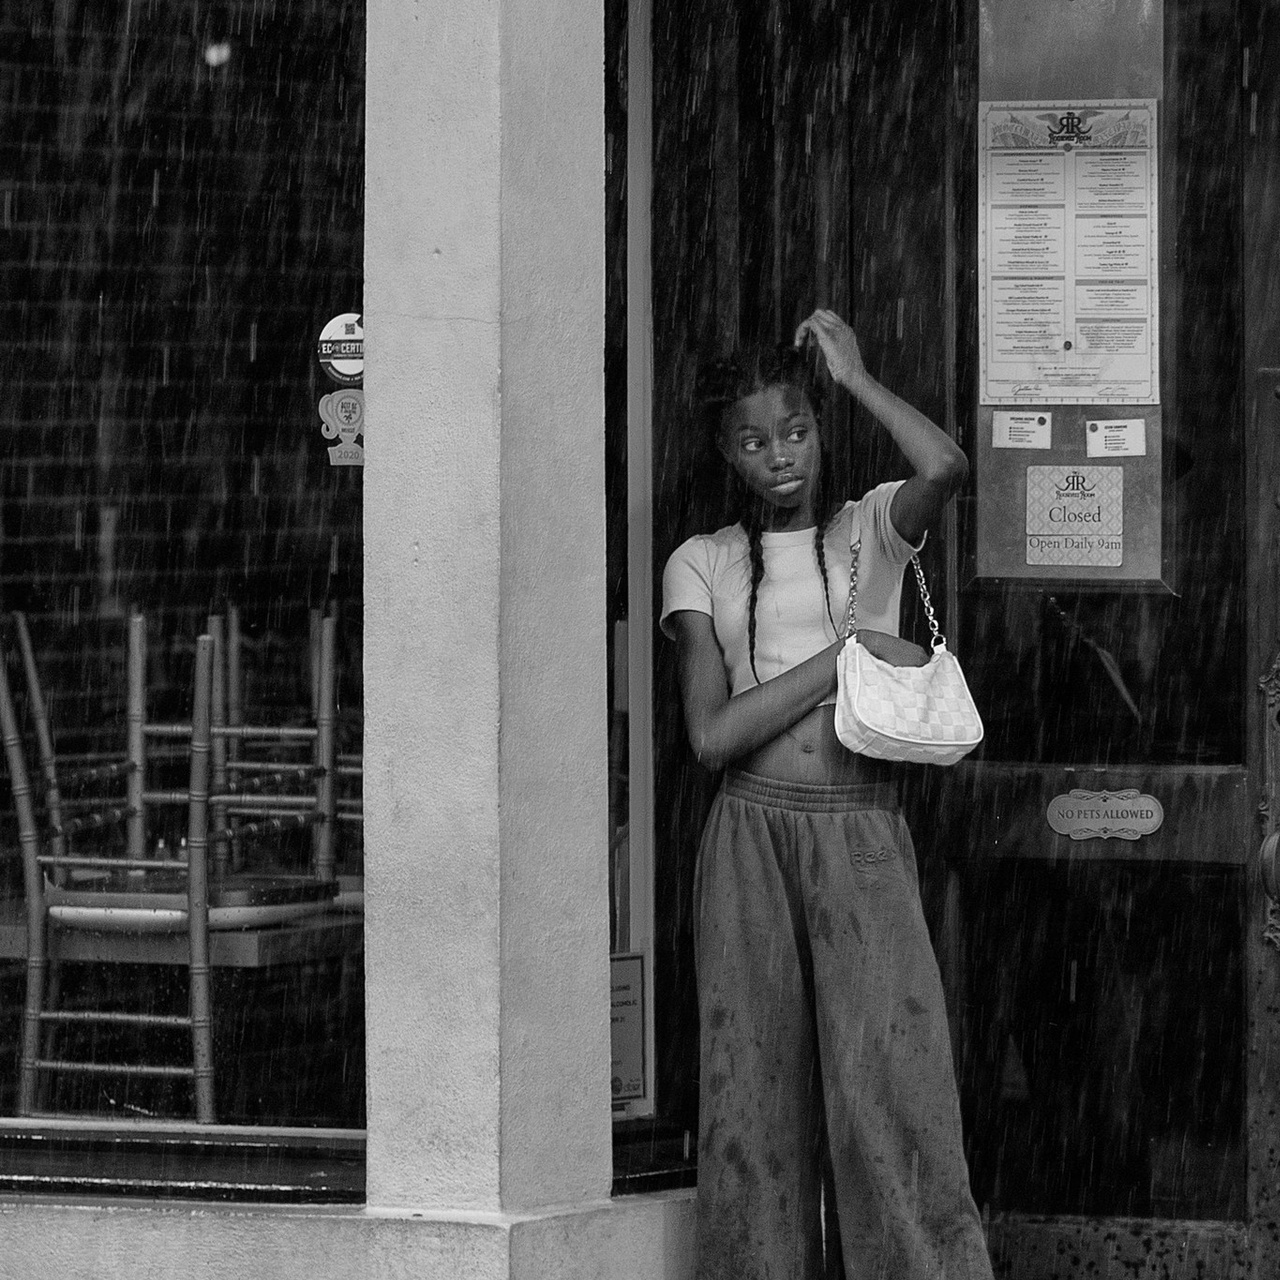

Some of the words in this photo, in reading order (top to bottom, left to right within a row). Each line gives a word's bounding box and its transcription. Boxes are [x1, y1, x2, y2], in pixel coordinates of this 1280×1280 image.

[337, 450, 360, 460] 2020
[1049, 506, 1101, 522] Closed
[1029, 537, 1060, 552] Open
[1064, 537, 1094, 553] Daily
[1097, 538, 1121, 549] 9am
[1058, 809, 1074, 819] NO
[1077, 809, 1100, 819] PETS
[1103, 809, 1154, 819] ALLOWED
